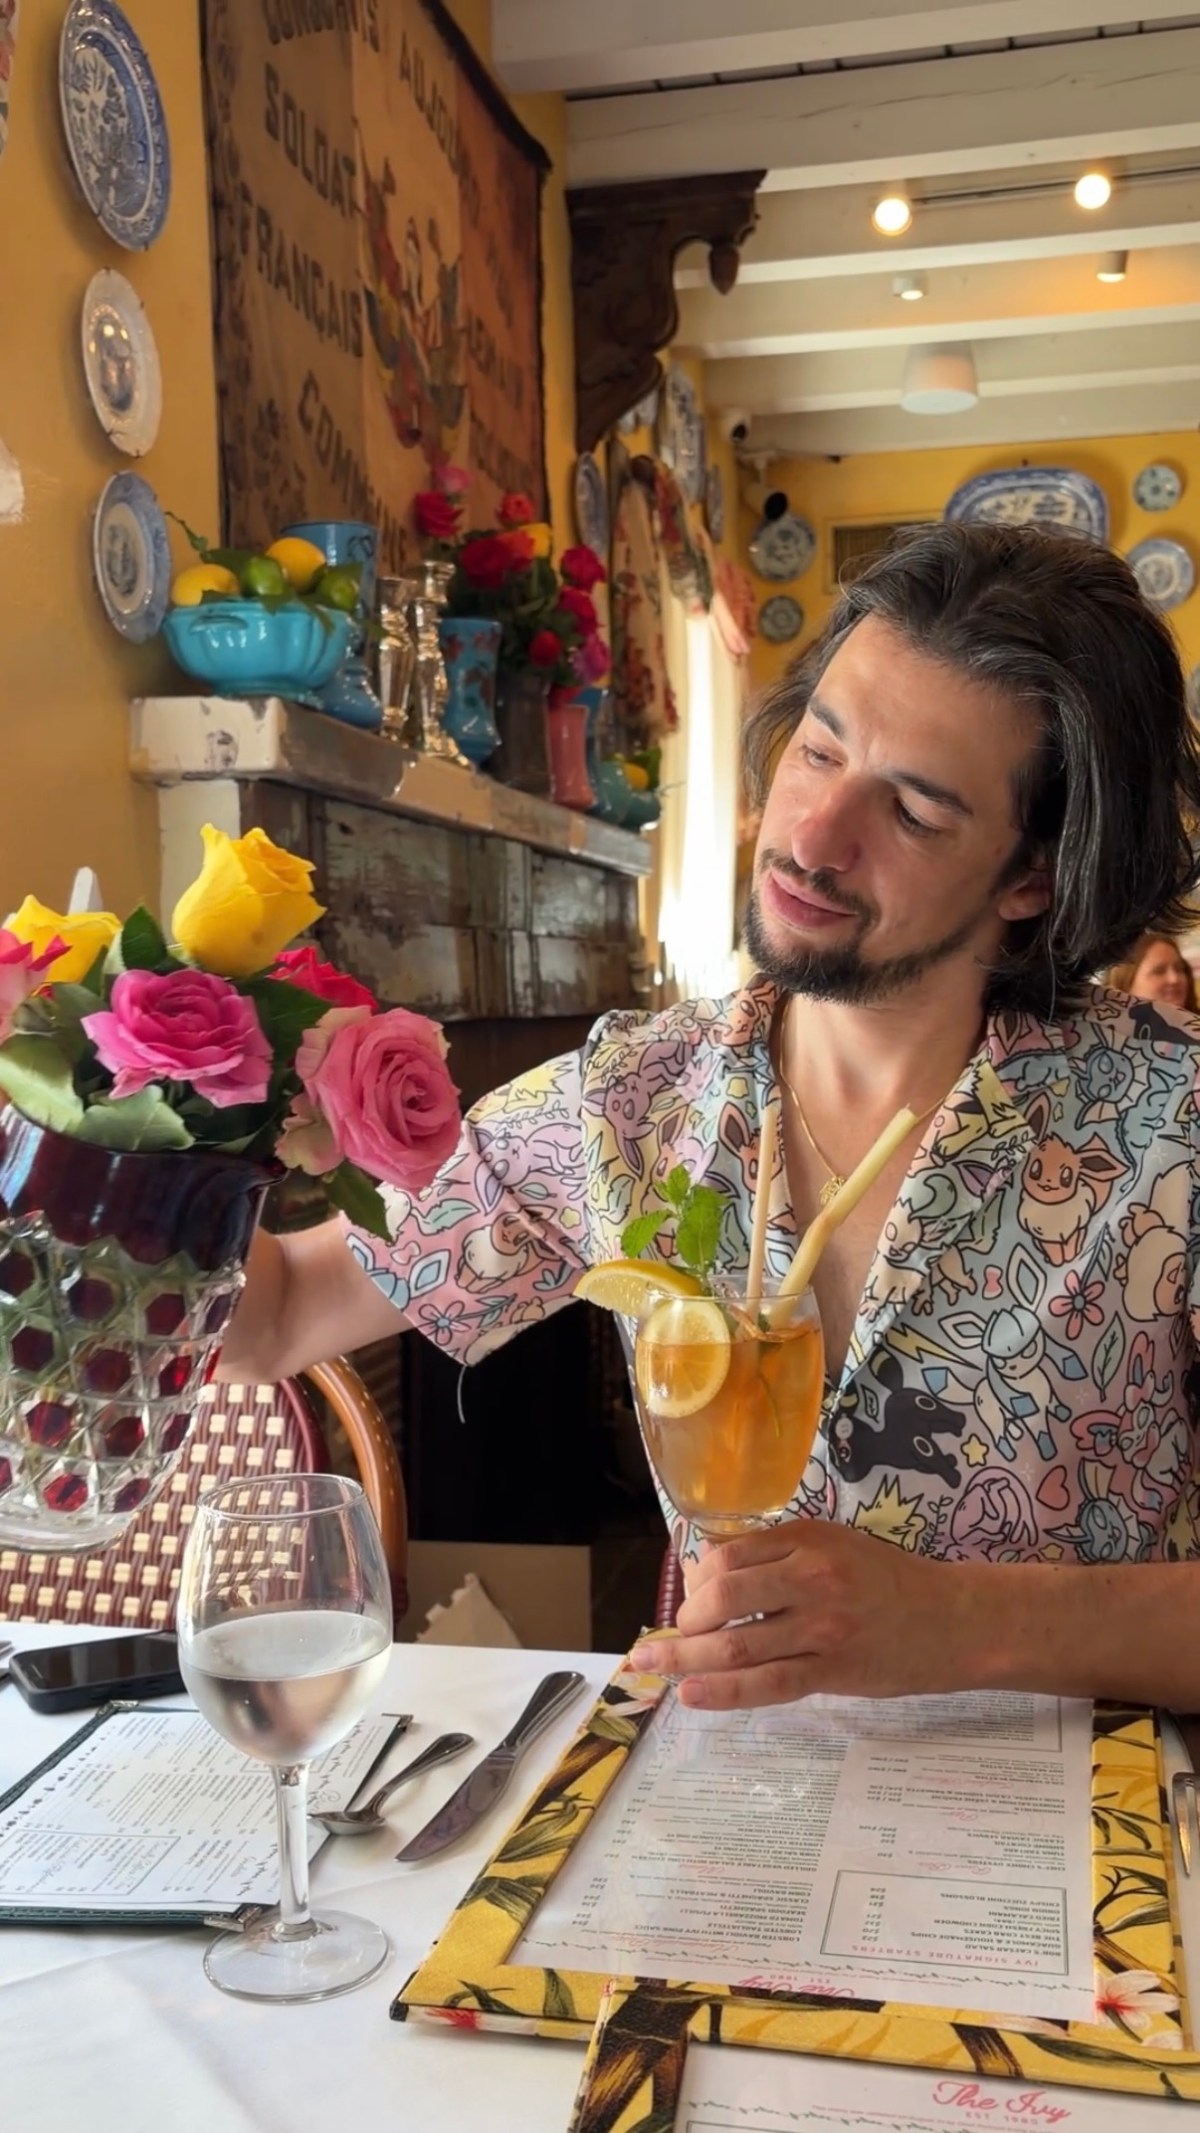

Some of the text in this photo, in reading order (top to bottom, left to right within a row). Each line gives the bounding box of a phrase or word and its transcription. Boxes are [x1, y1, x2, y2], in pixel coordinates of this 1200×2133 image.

[264, 61, 361, 219] SOLDAT
[932, 2080, 999, 2111] The
[1005, 2090, 1072, 2124] Ivy
[965, 2111, 989, 2121] EST
